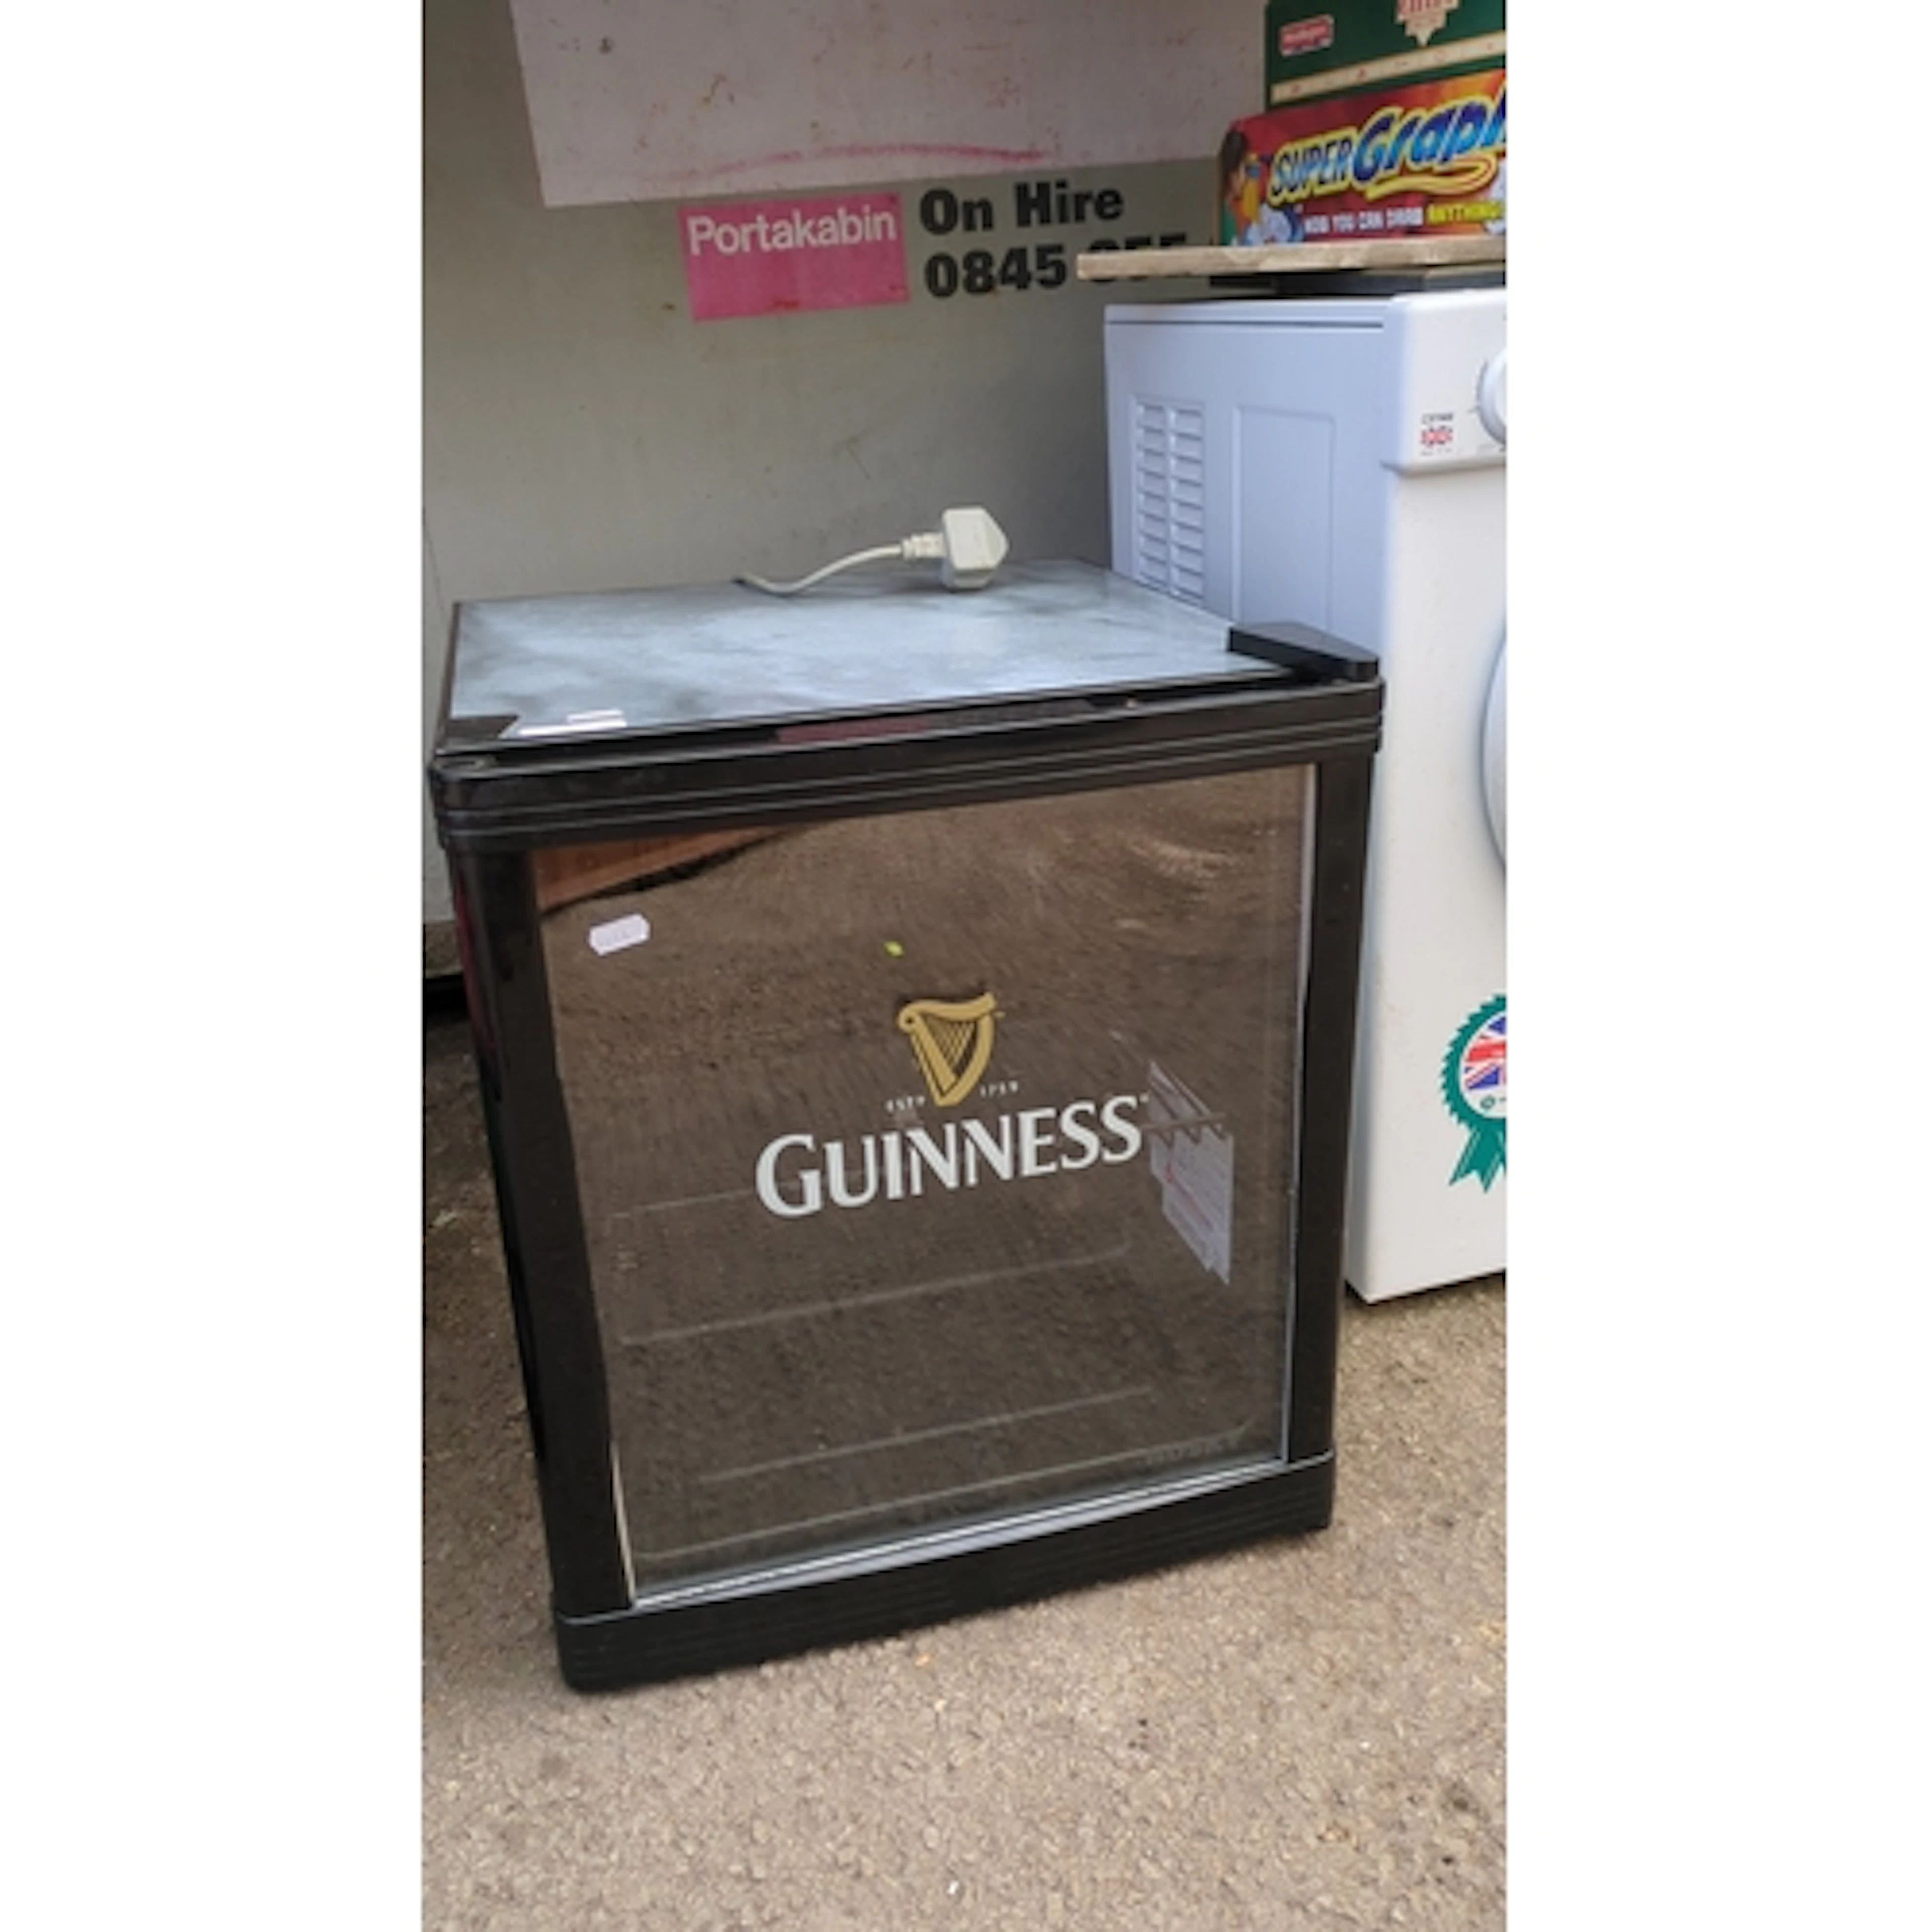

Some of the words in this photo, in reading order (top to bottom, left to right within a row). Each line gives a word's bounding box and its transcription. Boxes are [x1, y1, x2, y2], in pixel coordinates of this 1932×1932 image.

[686, 204, 898, 256] Portakabin
[919, 187, 995, 235] On
[1014, 179, 1124, 228] Hire
[924, 243, 1067, 298] 0845
[755, 1095, 1143, 1218] GUINNESS
